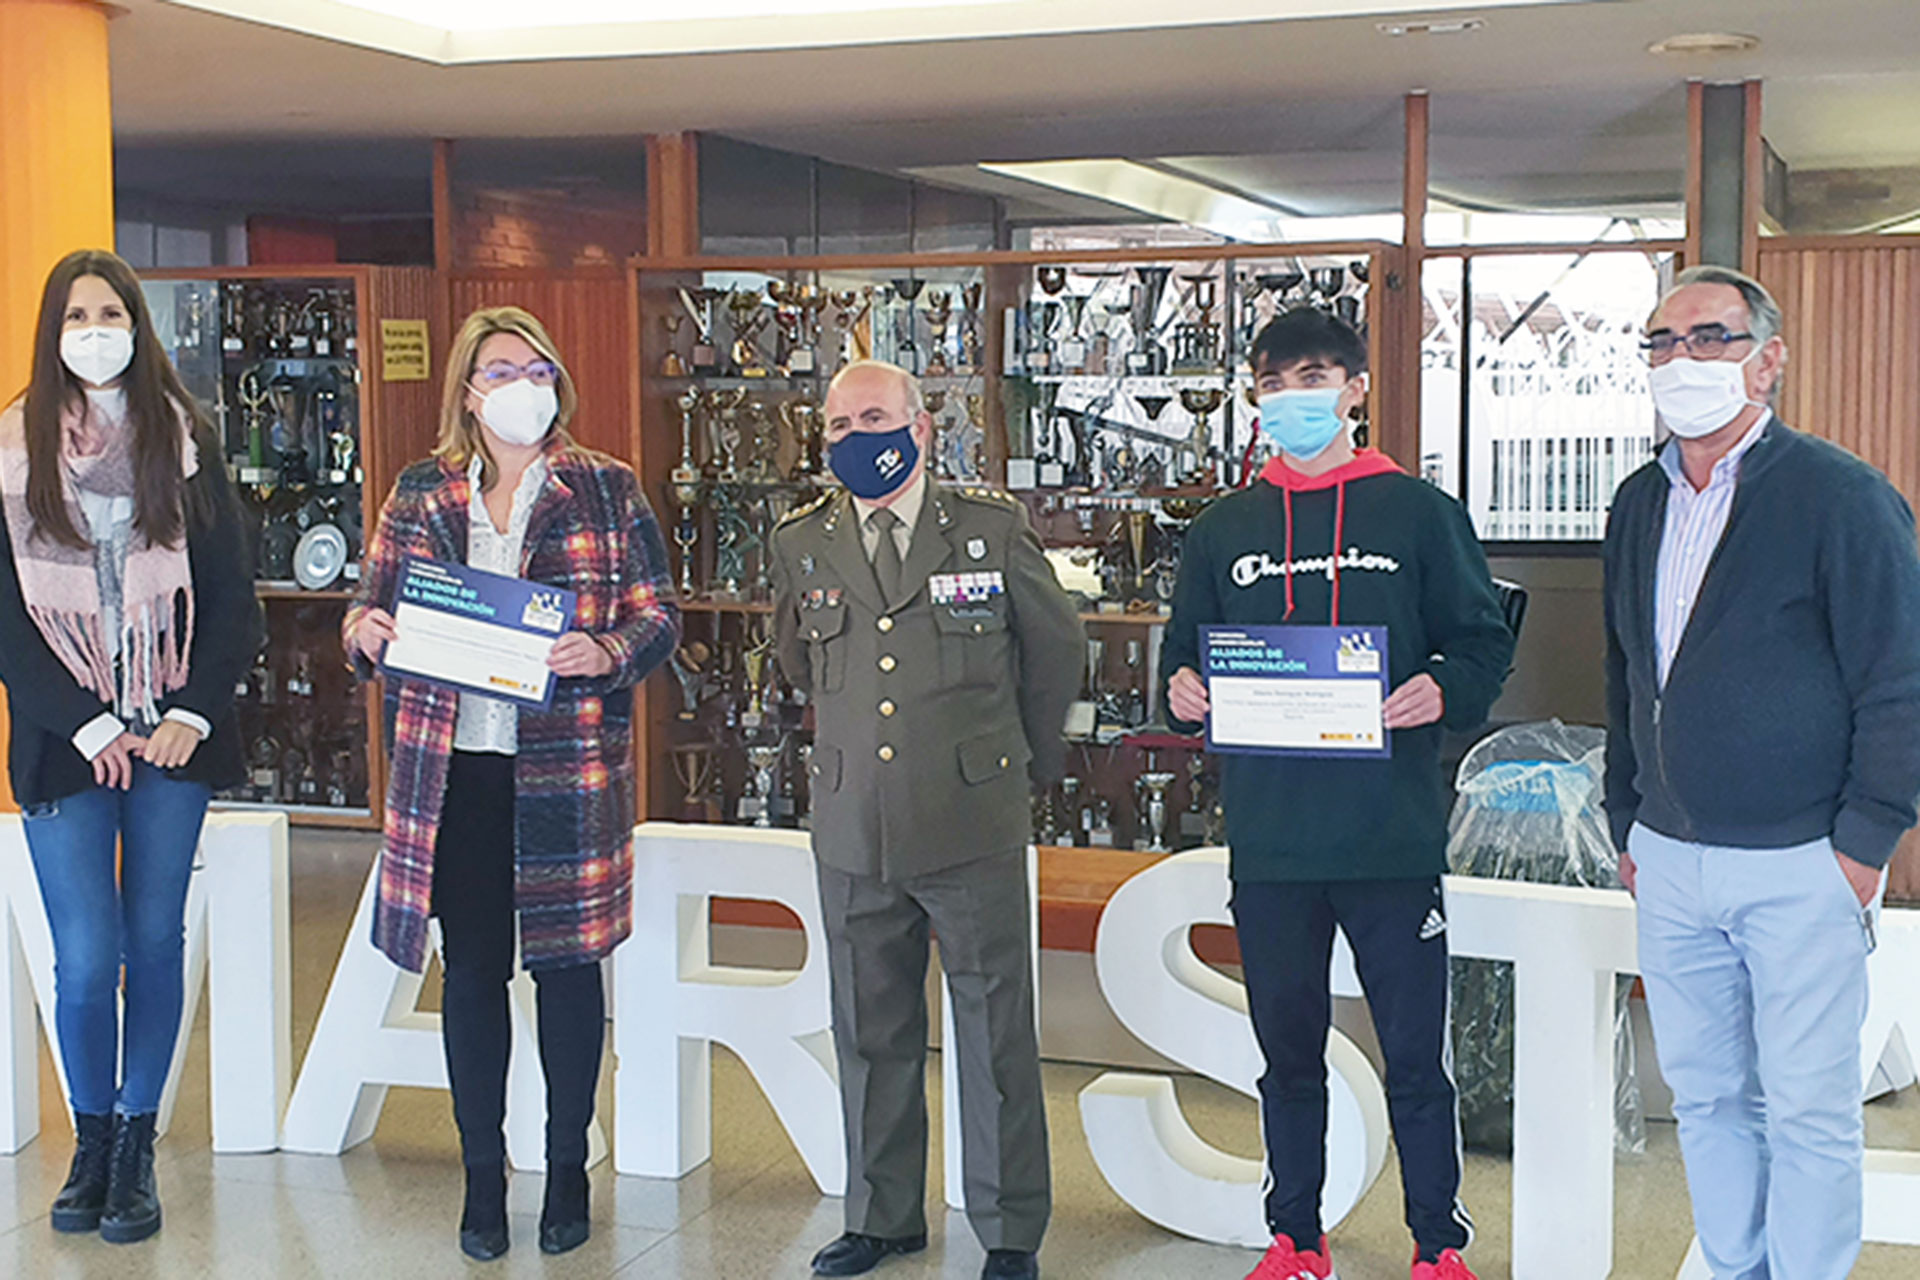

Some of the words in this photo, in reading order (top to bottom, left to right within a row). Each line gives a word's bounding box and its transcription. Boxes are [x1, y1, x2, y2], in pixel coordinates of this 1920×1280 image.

[1231, 547, 1399, 586] Champion
[403, 586, 420, 598] LA
[460, 587, 477, 600] DE
[1209, 648, 1263, 658] ALIADOS
[1265, 648, 1284, 659] DE
[1209, 660, 1227, 670] LA
[1229, 660, 1307, 672] INNOVACIÓN
